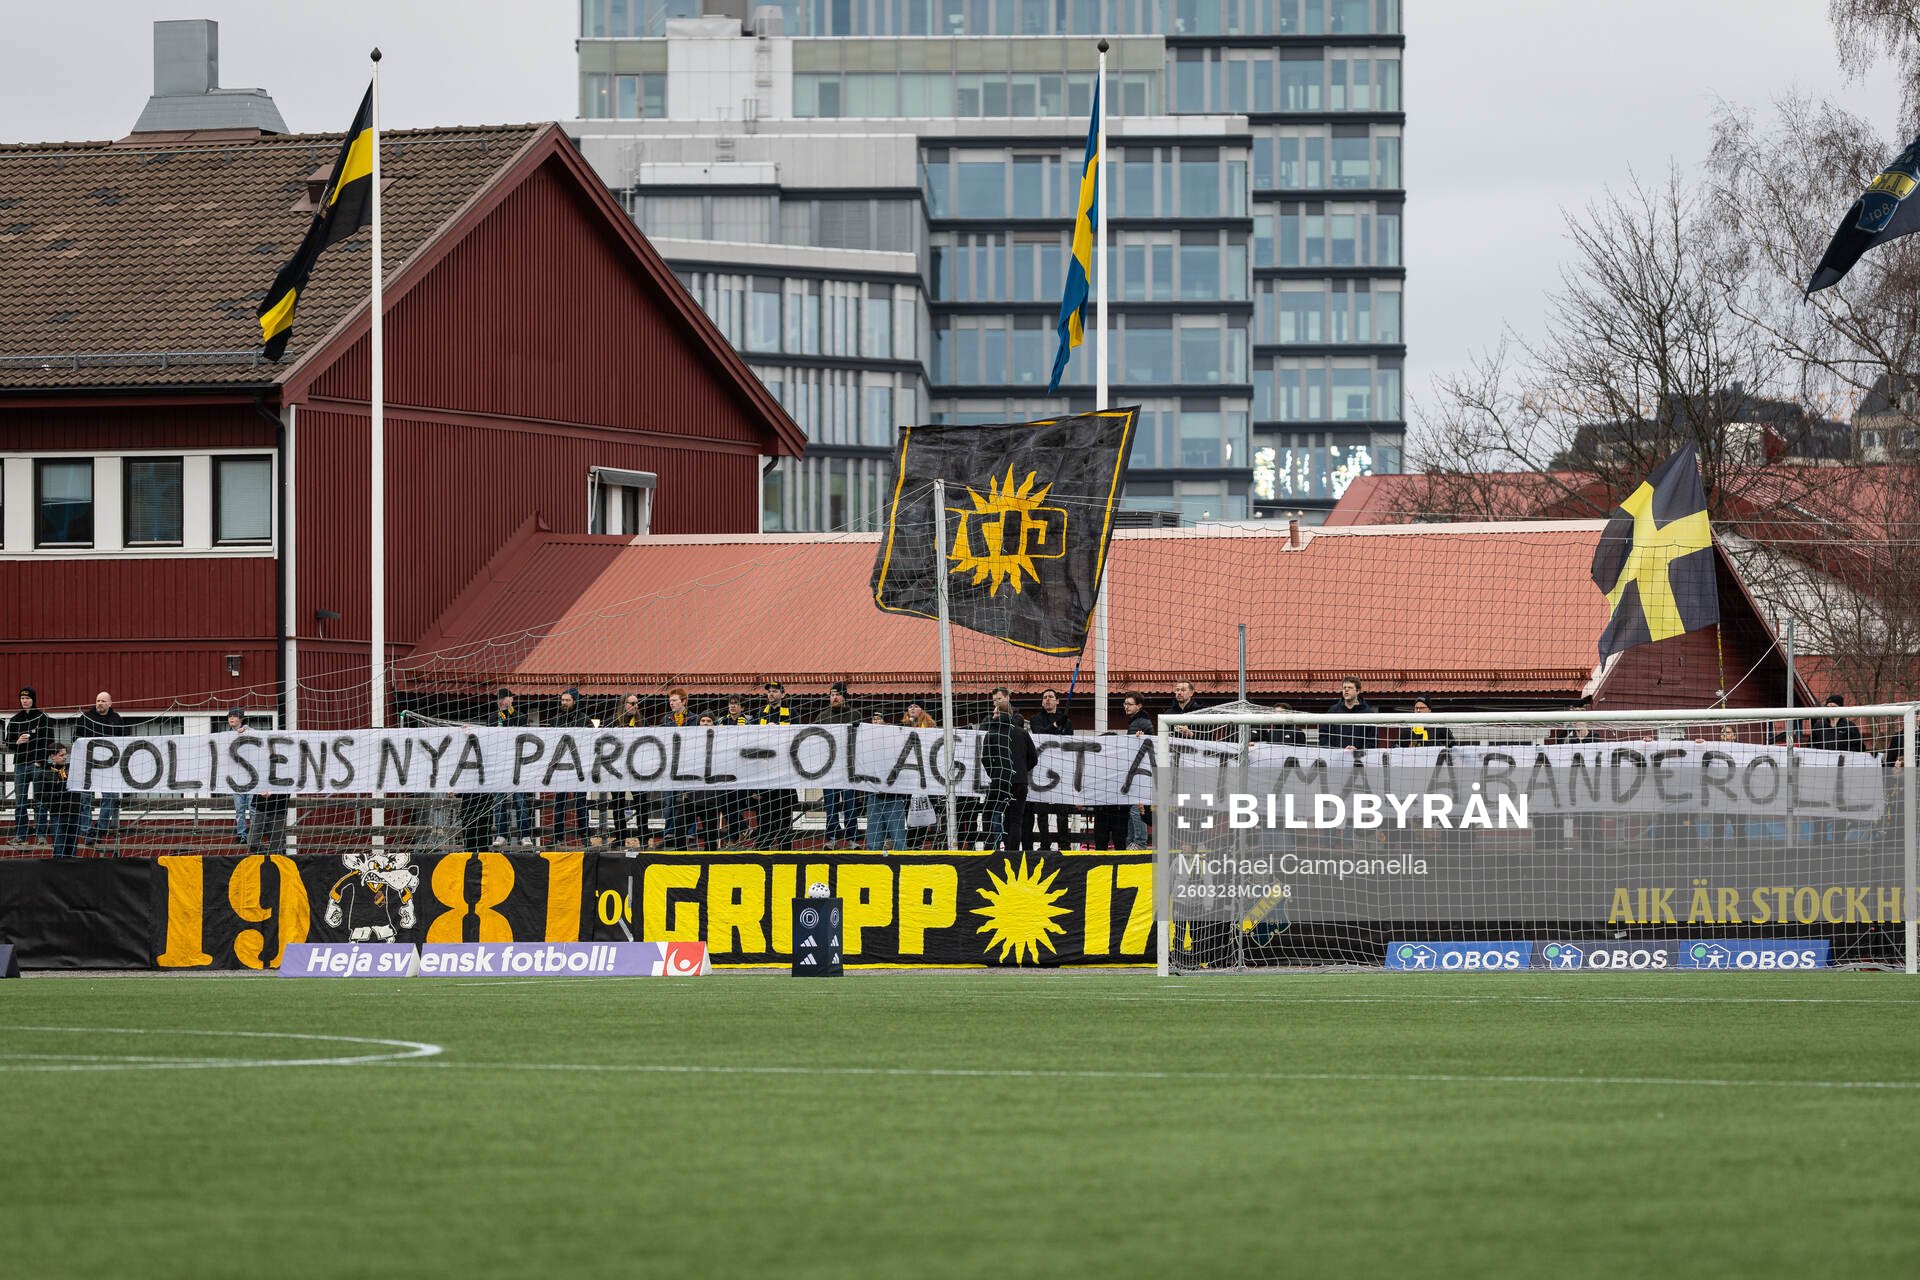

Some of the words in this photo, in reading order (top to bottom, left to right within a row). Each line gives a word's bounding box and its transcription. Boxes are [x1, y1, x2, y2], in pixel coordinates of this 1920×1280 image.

[84, 735, 356, 793] POLISENS
[377, 732, 486, 790] NYA
[514, 732, 737, 786] PAROLL
[1479, 747, 1873, 813] BANDEROLL
[643, 863, 958, 955] GRUPP
[1084, 863, 1160, 954] 17
[1608, 887, 1678, 924] AIK
[1687, 878, 1743, 924] ÄR
[307, 946, 369, 977] Heja
[501, 946, 617, 973] fotboll!
[1441, 950, 1520, 969] OBOS
[1588, 950, 1668, 969] OBOS
[1735, 950, 1816, 969] OBOS
